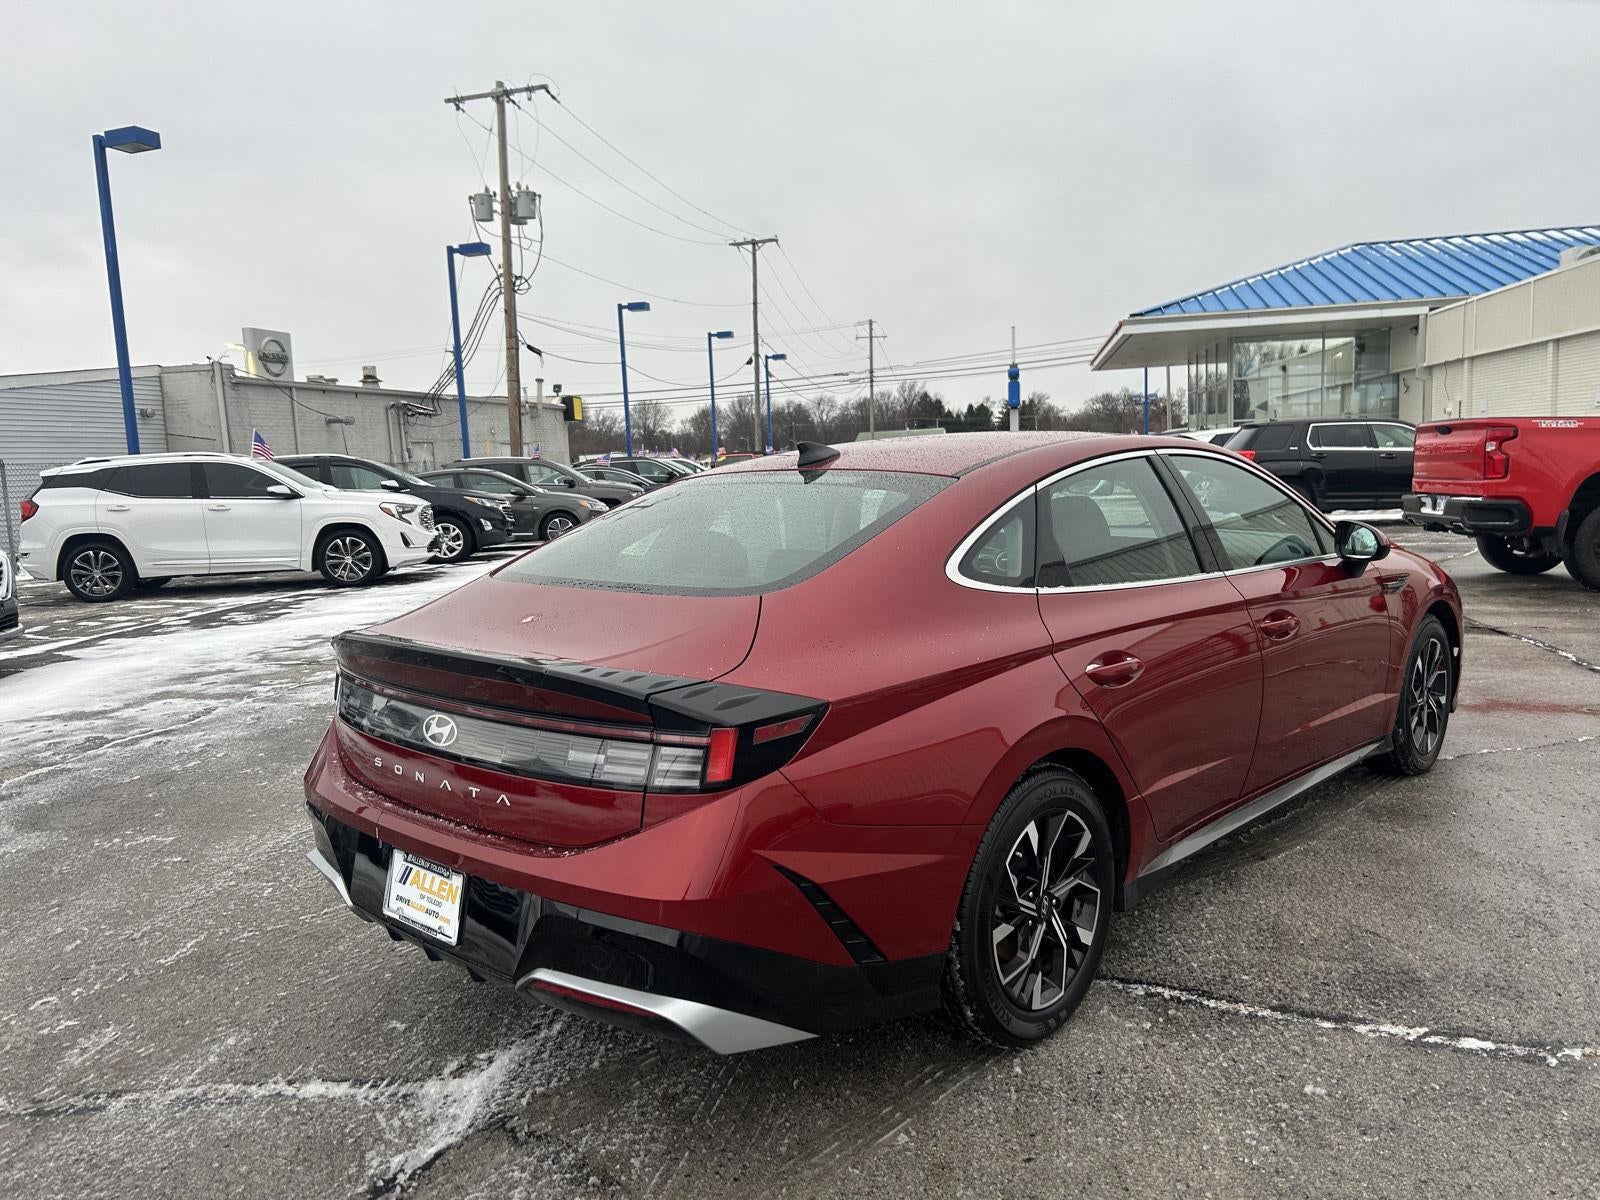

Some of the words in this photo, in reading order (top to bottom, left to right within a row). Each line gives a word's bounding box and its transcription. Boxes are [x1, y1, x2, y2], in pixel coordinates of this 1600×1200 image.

[374, 757, 511, 807] SONATA
[410, 869, 460, 905] ALLEN
[426, 895, 443, 908] TOLEDO
